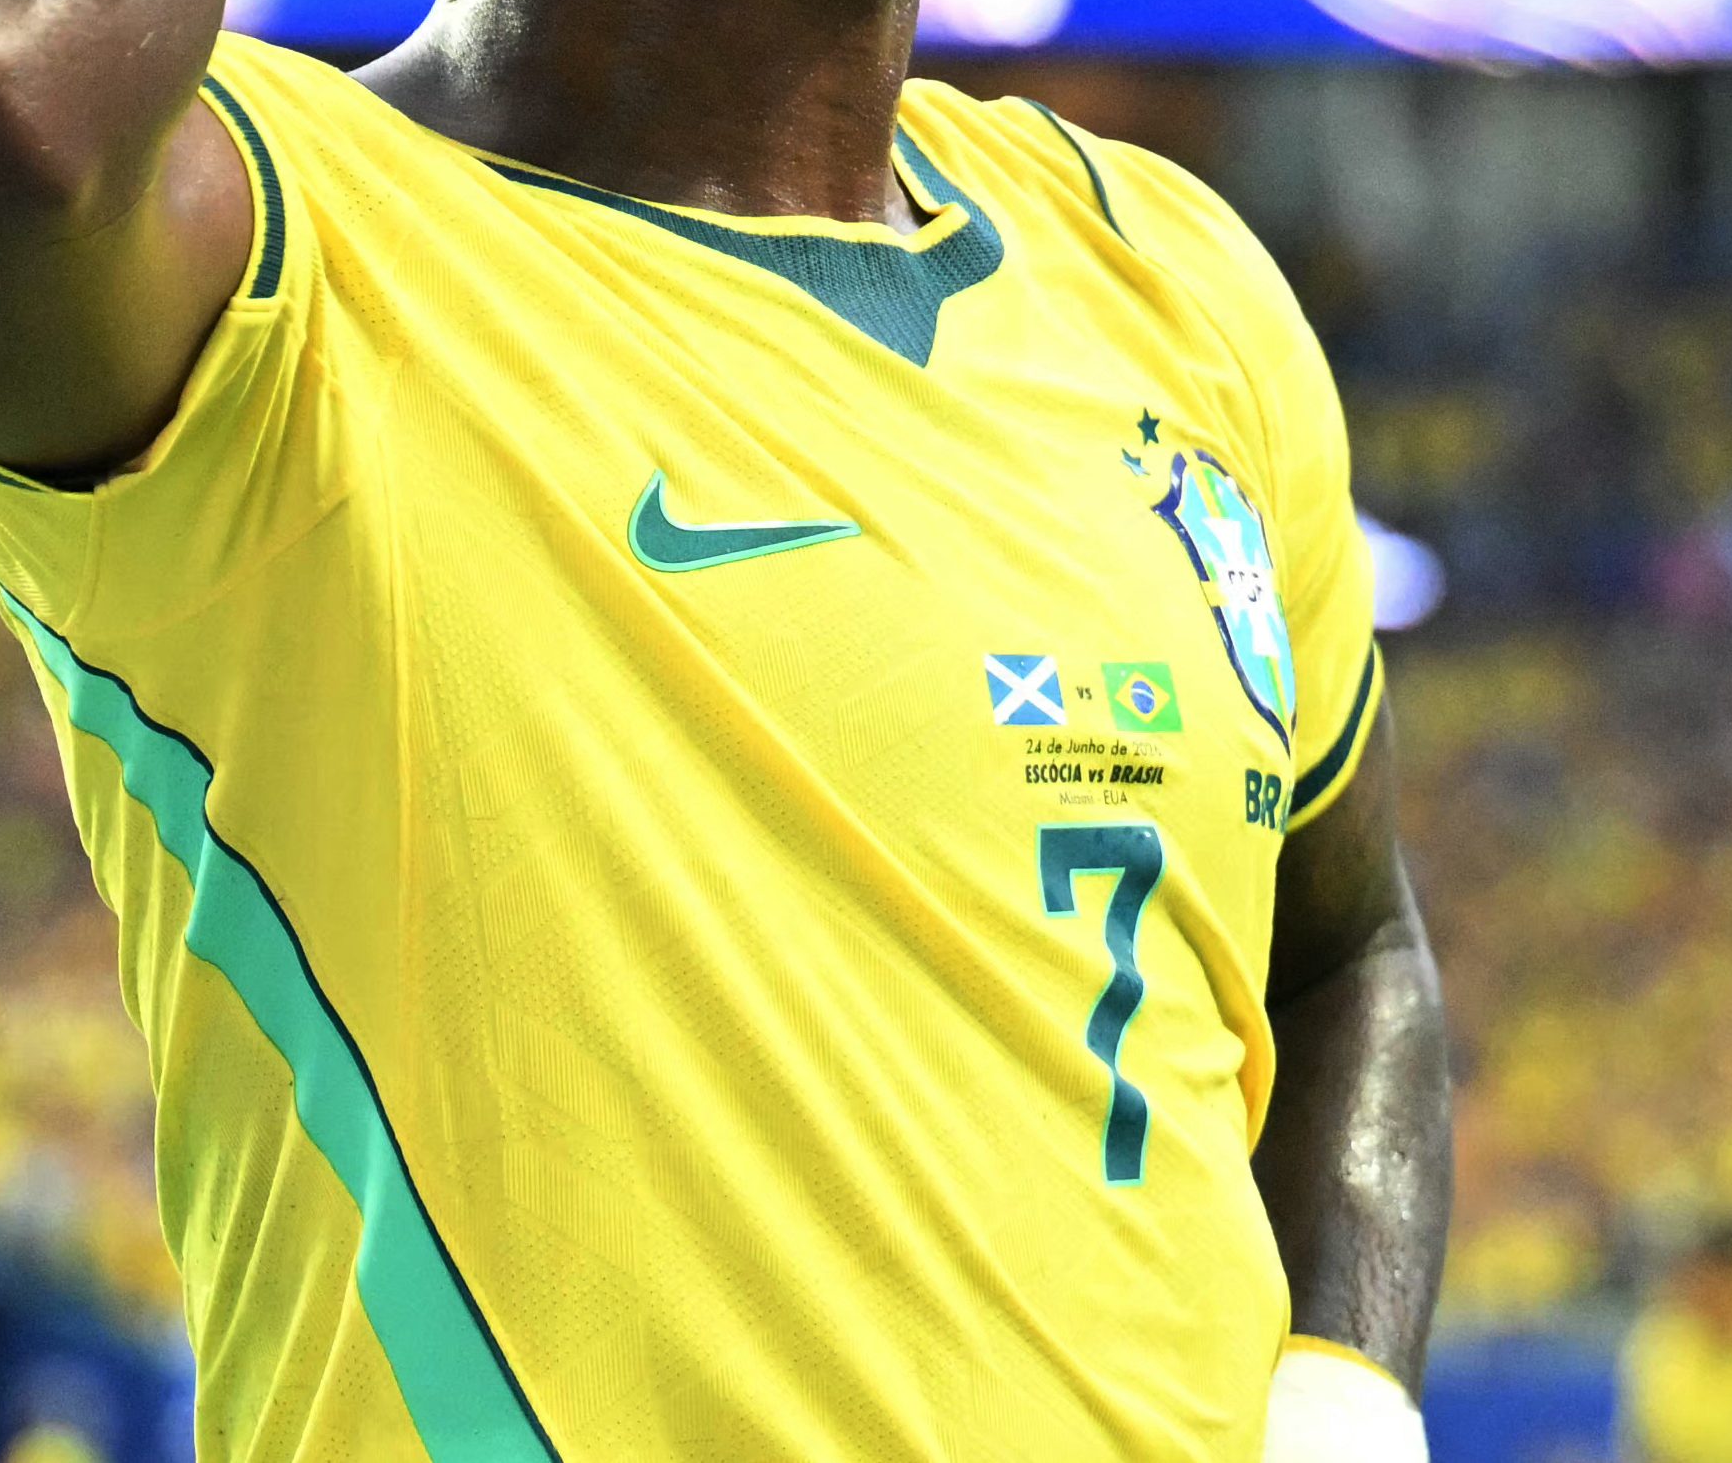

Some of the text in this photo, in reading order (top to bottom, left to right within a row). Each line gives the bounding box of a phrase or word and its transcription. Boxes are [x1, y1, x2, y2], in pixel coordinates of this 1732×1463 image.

[1026, 738, 1042, 754] 24
[1046, 737, 1062, 754] de
[1065, 737, 1105, 754] Junho
[1110, 739, 1127, 756] de
[1025, 758, 1164, 785] ESCÓCIA vs BRASIL
[1103, 789, 1128, 805] EUA
[1037, 821, 1165, 1185] 7
